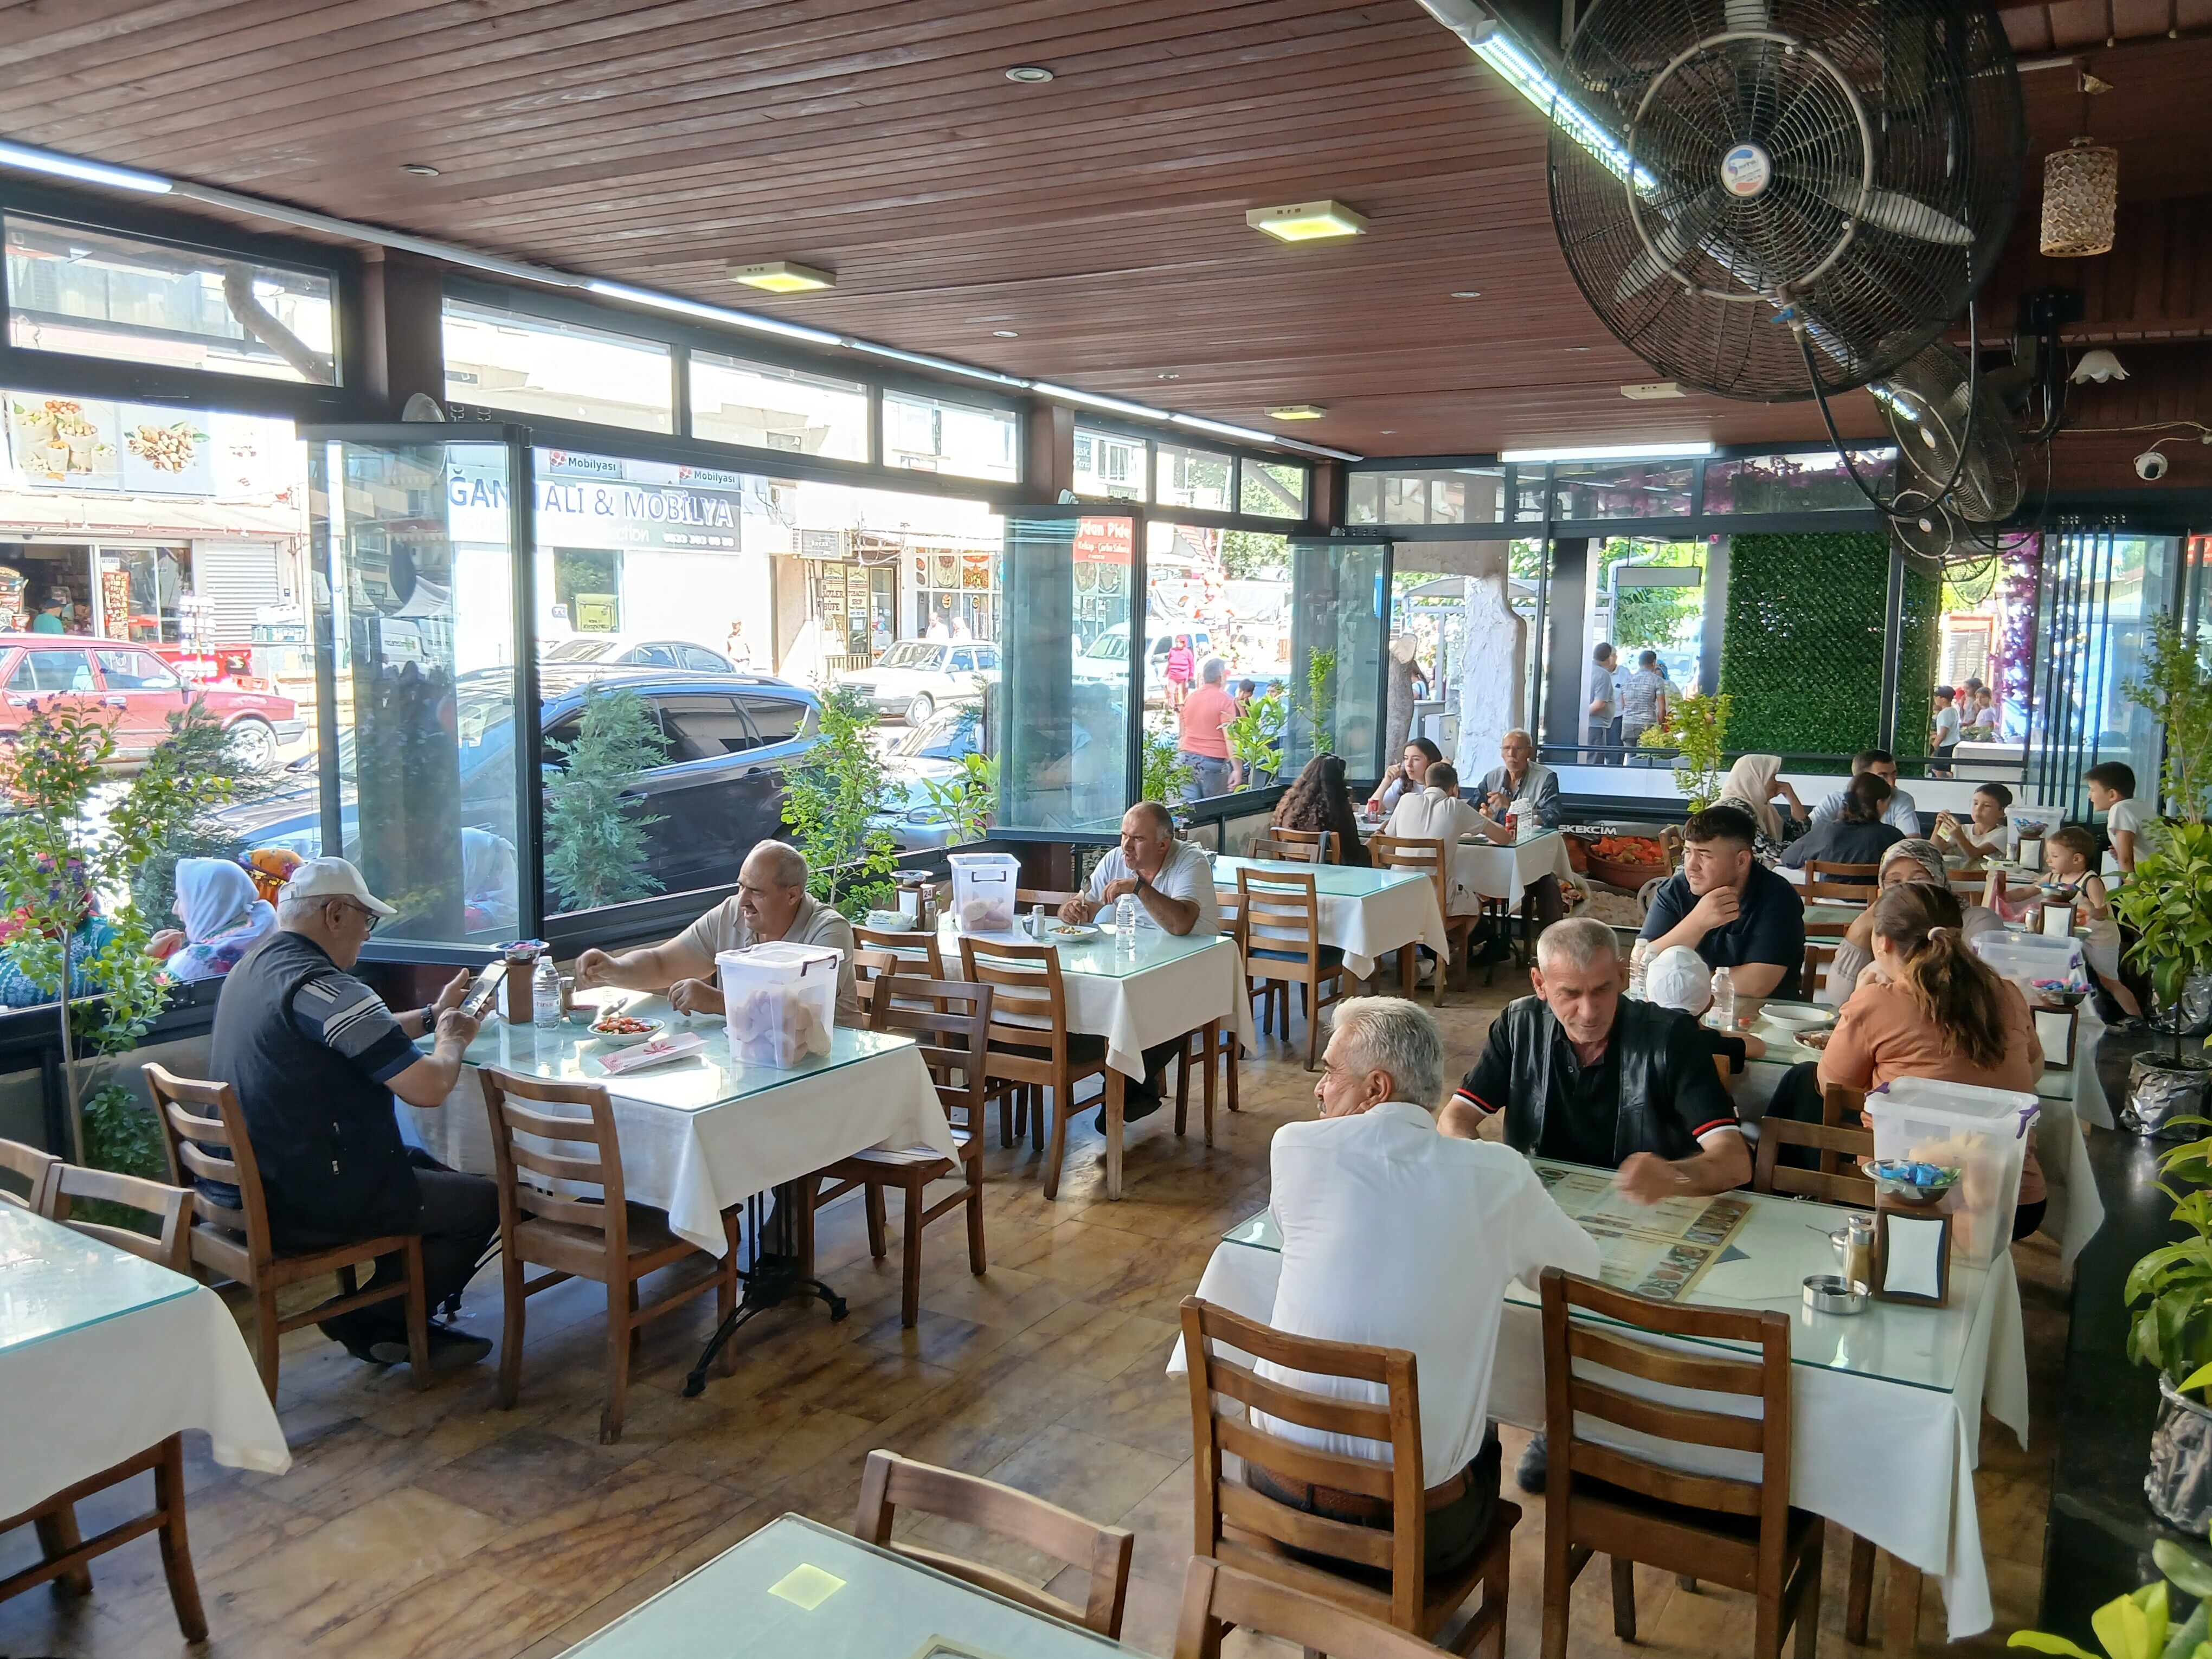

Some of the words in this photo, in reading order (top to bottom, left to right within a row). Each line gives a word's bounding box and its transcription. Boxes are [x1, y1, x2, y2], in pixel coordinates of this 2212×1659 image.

[568, 457, 616, 472] Mobilyası
[694, 471, 735, 484] Mobilyası
[535, 484, 584, 513] ALI
[595, 489, 614, 516] &
[625, 489, 735, 528] MOBİLYA
[1558, 822, 1618, 835] ŞKEKCİM
[924, 889, 931, 897] 24
